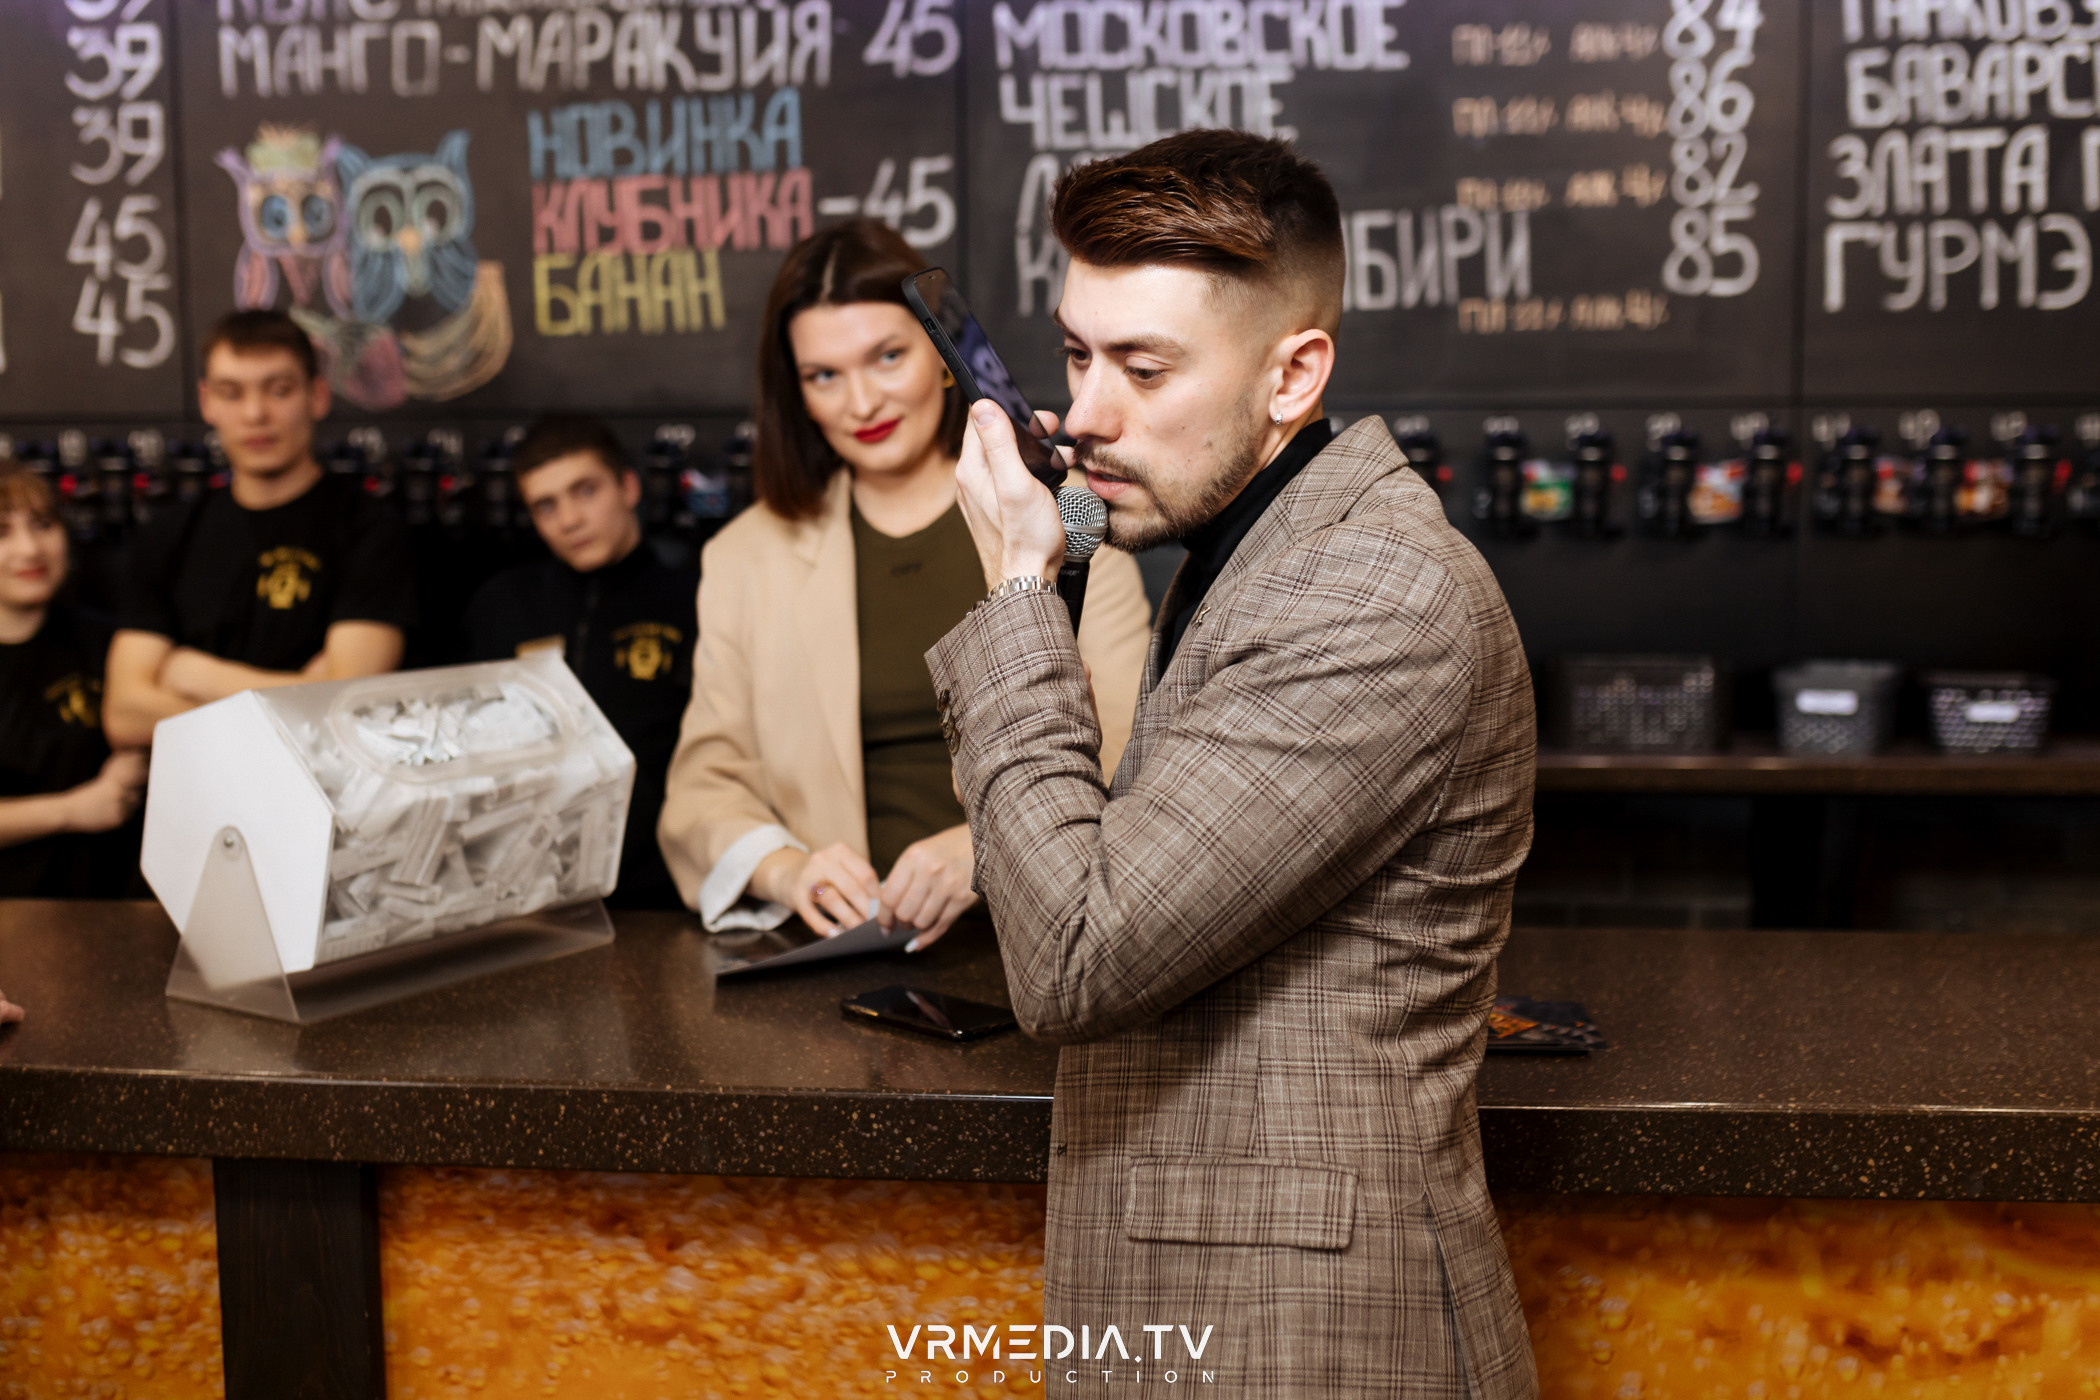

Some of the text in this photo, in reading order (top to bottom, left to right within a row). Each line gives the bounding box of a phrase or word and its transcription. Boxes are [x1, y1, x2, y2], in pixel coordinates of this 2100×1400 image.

[64, 21, 163, 101] 39
[862, 0, 962, 78] 45
[993, 0, 1410, 70] МОСКОВСКОЕ
[1661, 0, 1764, 60] 84
[999, 67, 1300, 150] ЧЕШСКОЕ
[1666, 51, 1755, 141] 86
[1845, 39, 2100, 128] БАВАРС
[70, 100, 165, 187] 39
[527, 86, 803, 180] НОВИНКА
[1670, 131, 1760, 207] 82
[1825, 124, 2049, 218] ЗЛАТА
[66, 194, 168, 282] 45
[530, 167, 814, 254] КЛУБНИКА
[532, 248, 727, 337] БАНАН
[1342, 203, 1532, 312] БИРИ
[1661, 204, 1761, 297] 85
[1824, 212, 2093, 313] ГУРМЭ
[72, 271, 176, 369] 45
